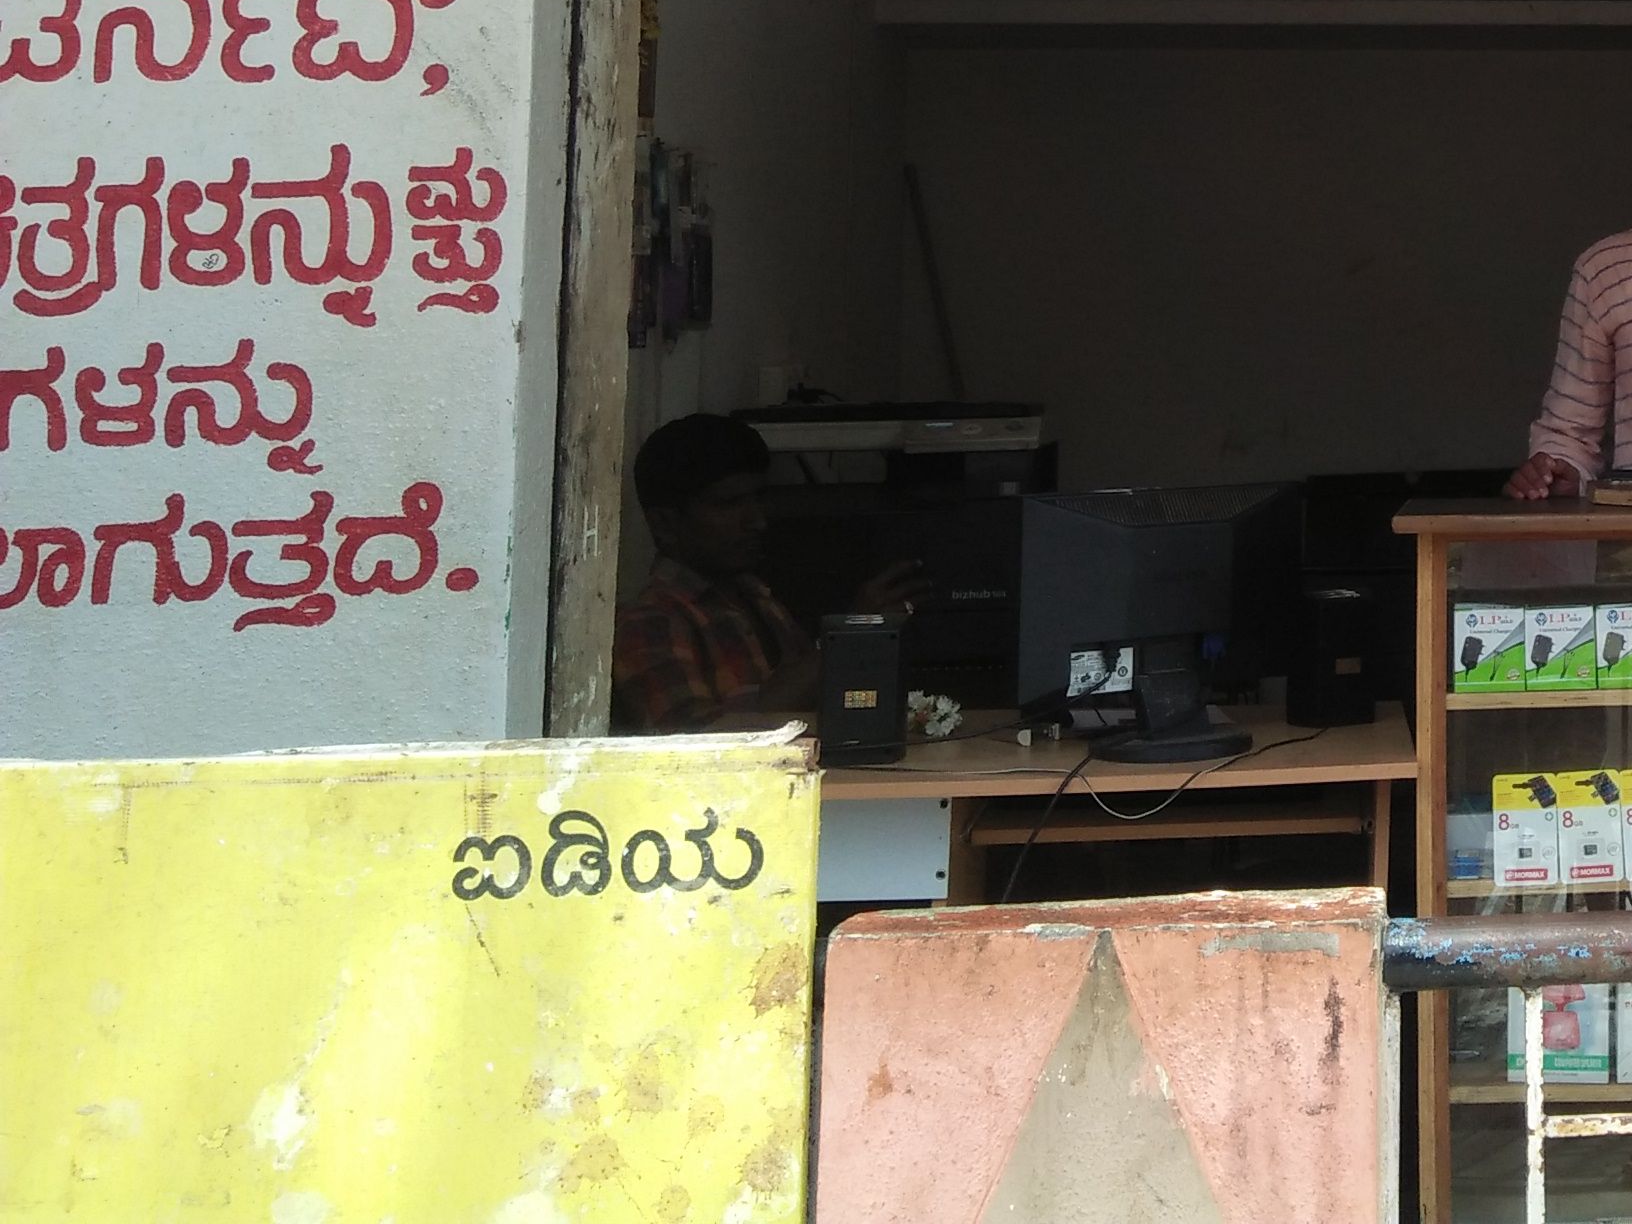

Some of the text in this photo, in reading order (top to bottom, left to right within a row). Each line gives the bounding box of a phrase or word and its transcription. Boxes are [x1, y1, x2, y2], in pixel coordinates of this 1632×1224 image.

[0, 143, 393, 328] ತ್ರಗಳನ್ನು
[952, 588, 991, 599] bizhub
[1498, 813, 1509, 830] 8
[1562, 811, 1573, 828] 8
